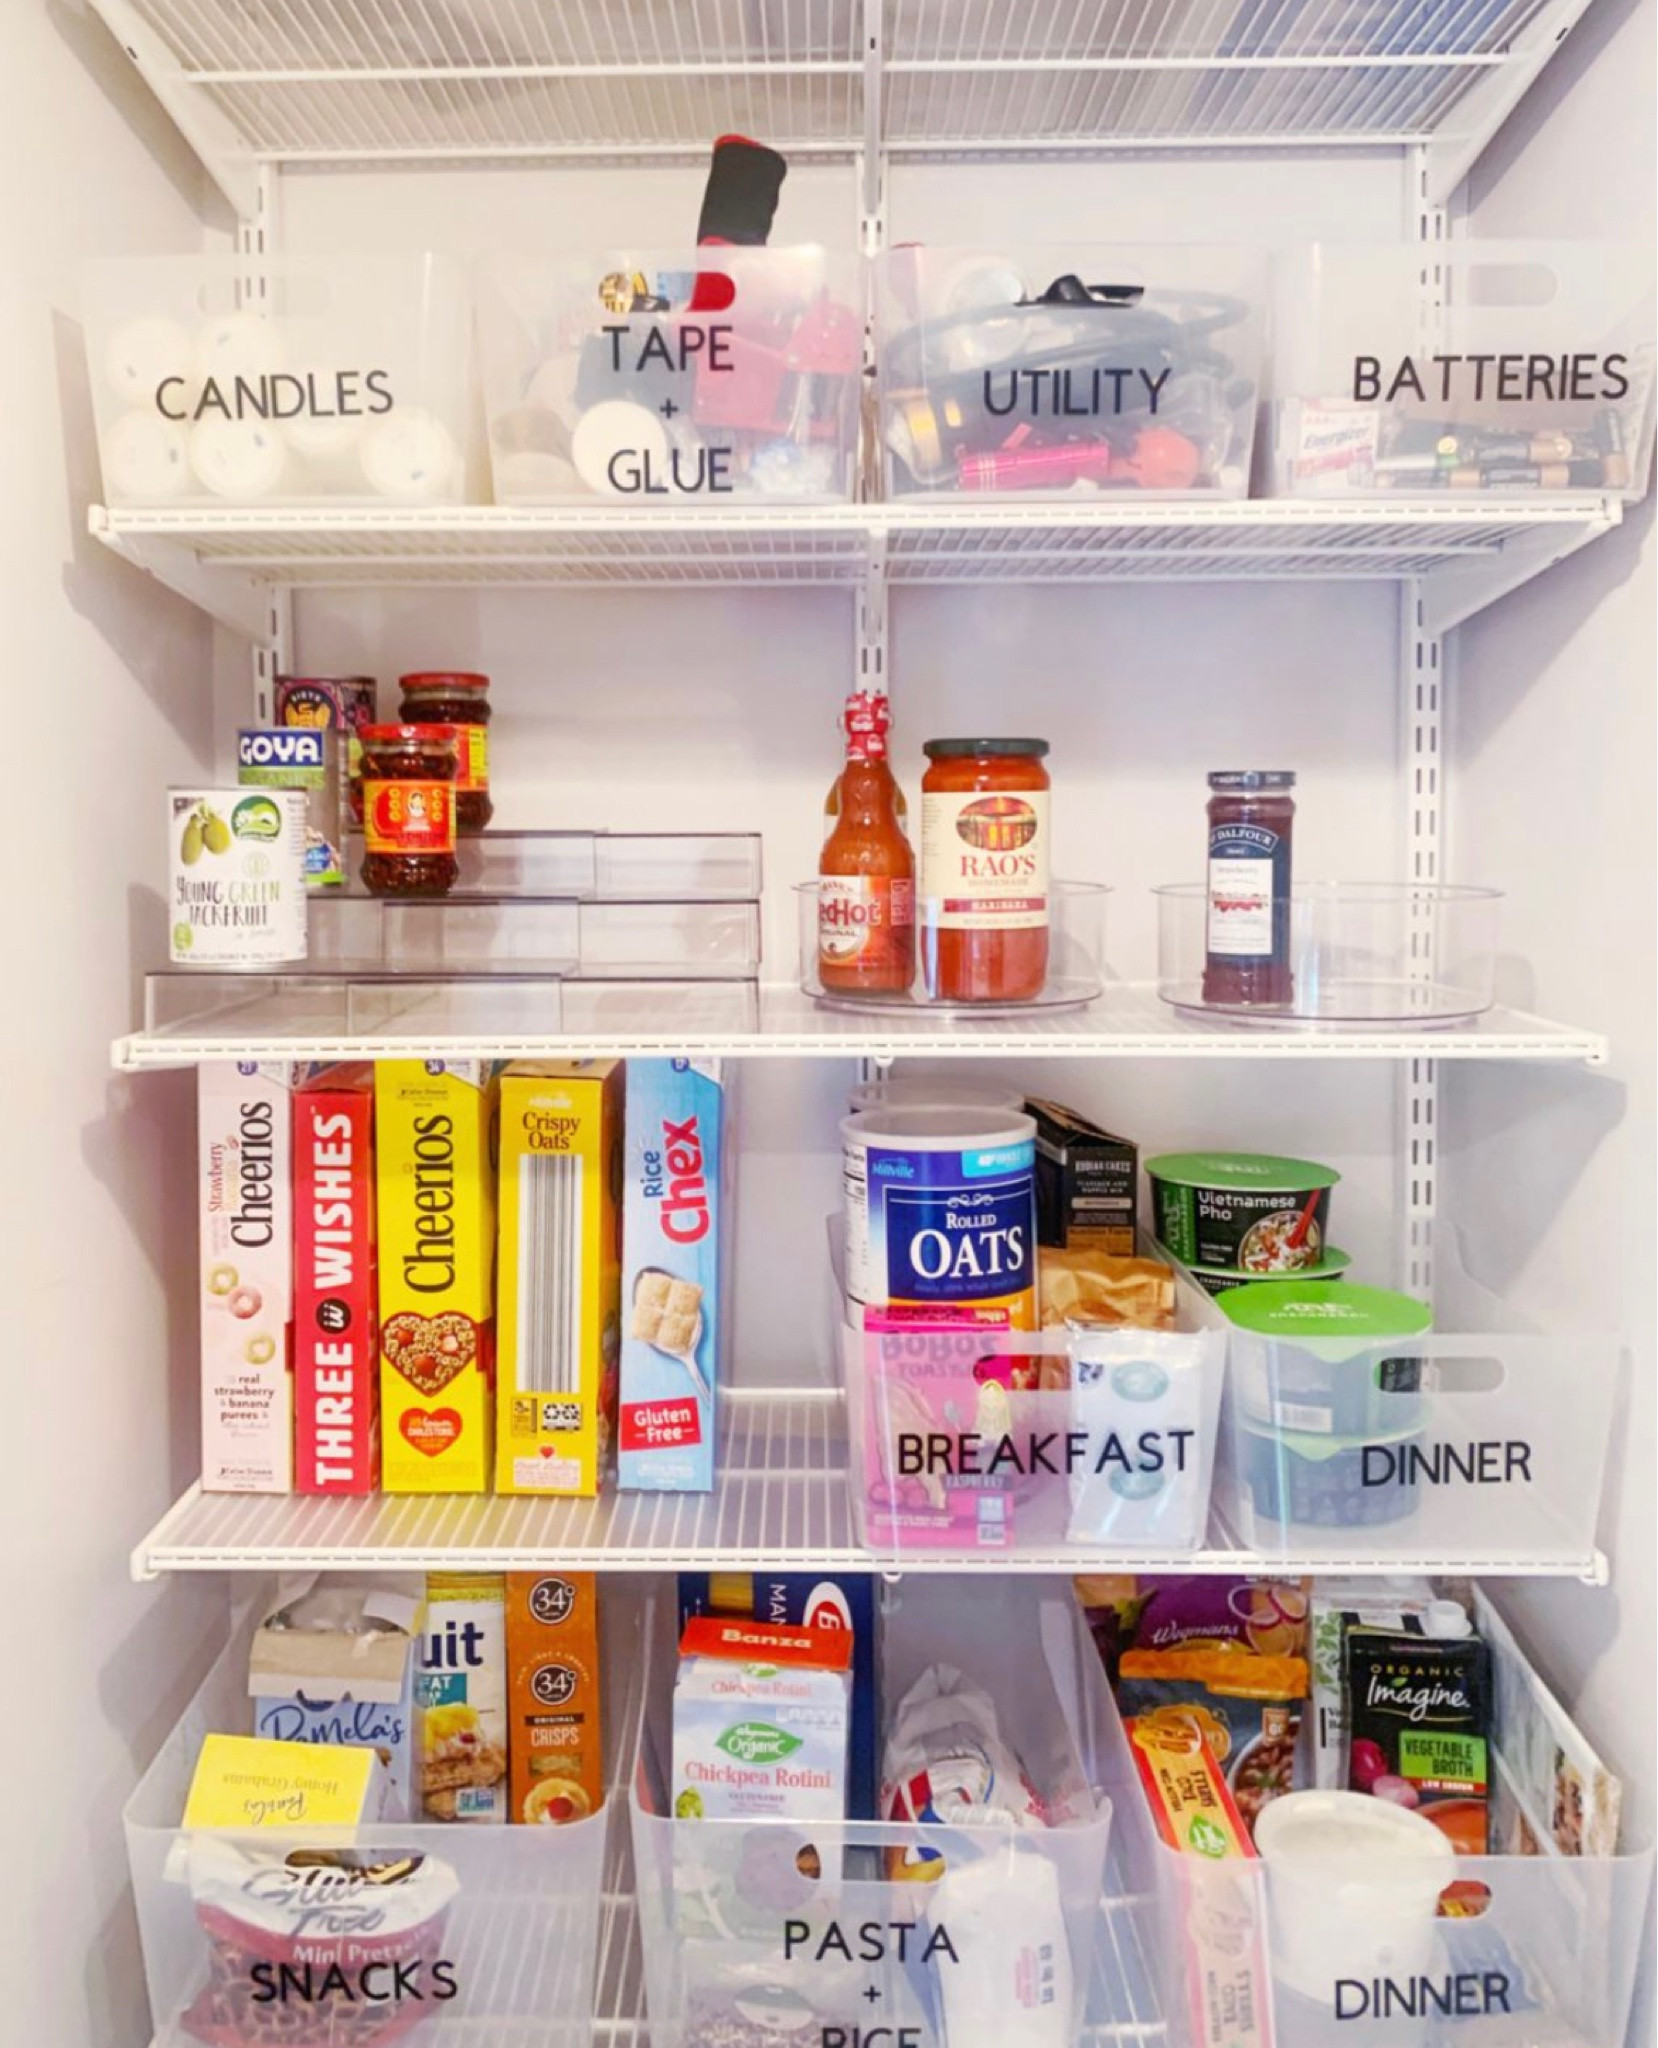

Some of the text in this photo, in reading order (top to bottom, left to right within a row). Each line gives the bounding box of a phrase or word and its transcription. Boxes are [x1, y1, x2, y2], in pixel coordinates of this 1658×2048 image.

[602, 325, 735, 373] TAPE
[1352, 353, 1629, 403] BATTERIES
[155, 370, 394, 422] CANDLES
[982, 368, 1173, 417] UTILITY
[659, 397, 679, 419] +
[607, 446, 734, 494] GLUE
[240, 735, 320, 766] GOYA
[961, 853, 1037, 878] RAO'S
[176, 875, 224, 905] YOUNG
[189, 904, 269, 928] JACKFRUIT
[522, 1111, 582, 1137] Crispy
[528, 1131, 571, 1150] Oats
[231, 1101, 274, 1249] Cheerios
[643, 1151, 665, 1198] Rice
[660, 1115, 710, 1245] Chex
[313, 1113, 354, 1290] WISHES
[403, 1115, 456, 1294] Cheerios
[1199, 1205, 1233, 1222] Pho
[909, 1225, 1025, 1280] OATS
[214, 1385, 275, 1399] strawberry
[239, 1373, 260, 1385] real
[221, 1411, 259, 1422] purees
[229, 1398, 270, 1409] banana
[316, 1342, 353, 1486] THREE
[634, 1407, 692, 1428] Gluten
[646, 1427, 683, 1444] Free
[898, 1430, 1195, 1476] BREAKFAST
[1360, 1440, 1532, 1488] DINNER
[721, 1628, 812, 1649] Banza
[1153, 1620, 1239, 1645] Wegmans
[1370, 1663, 1465, 1677] ORGANIC
[531, 1726, 580, 1748] CRISPS
[1404, 1738, 1474, 1760] VEGETABLE
[684, 1761, 832, 1790] Chickpea Rotini
[1431, 1758, 1474, 1777] BROTH
[292, 1944, 342, 1965] Mini
[784, 1919, 960, 1964] PASTA
[250, 1959, 459, 2002] SNACKS
[862, 1985, 882, 2004] +
[1334, 1972, 1512, 2021] DINNER
